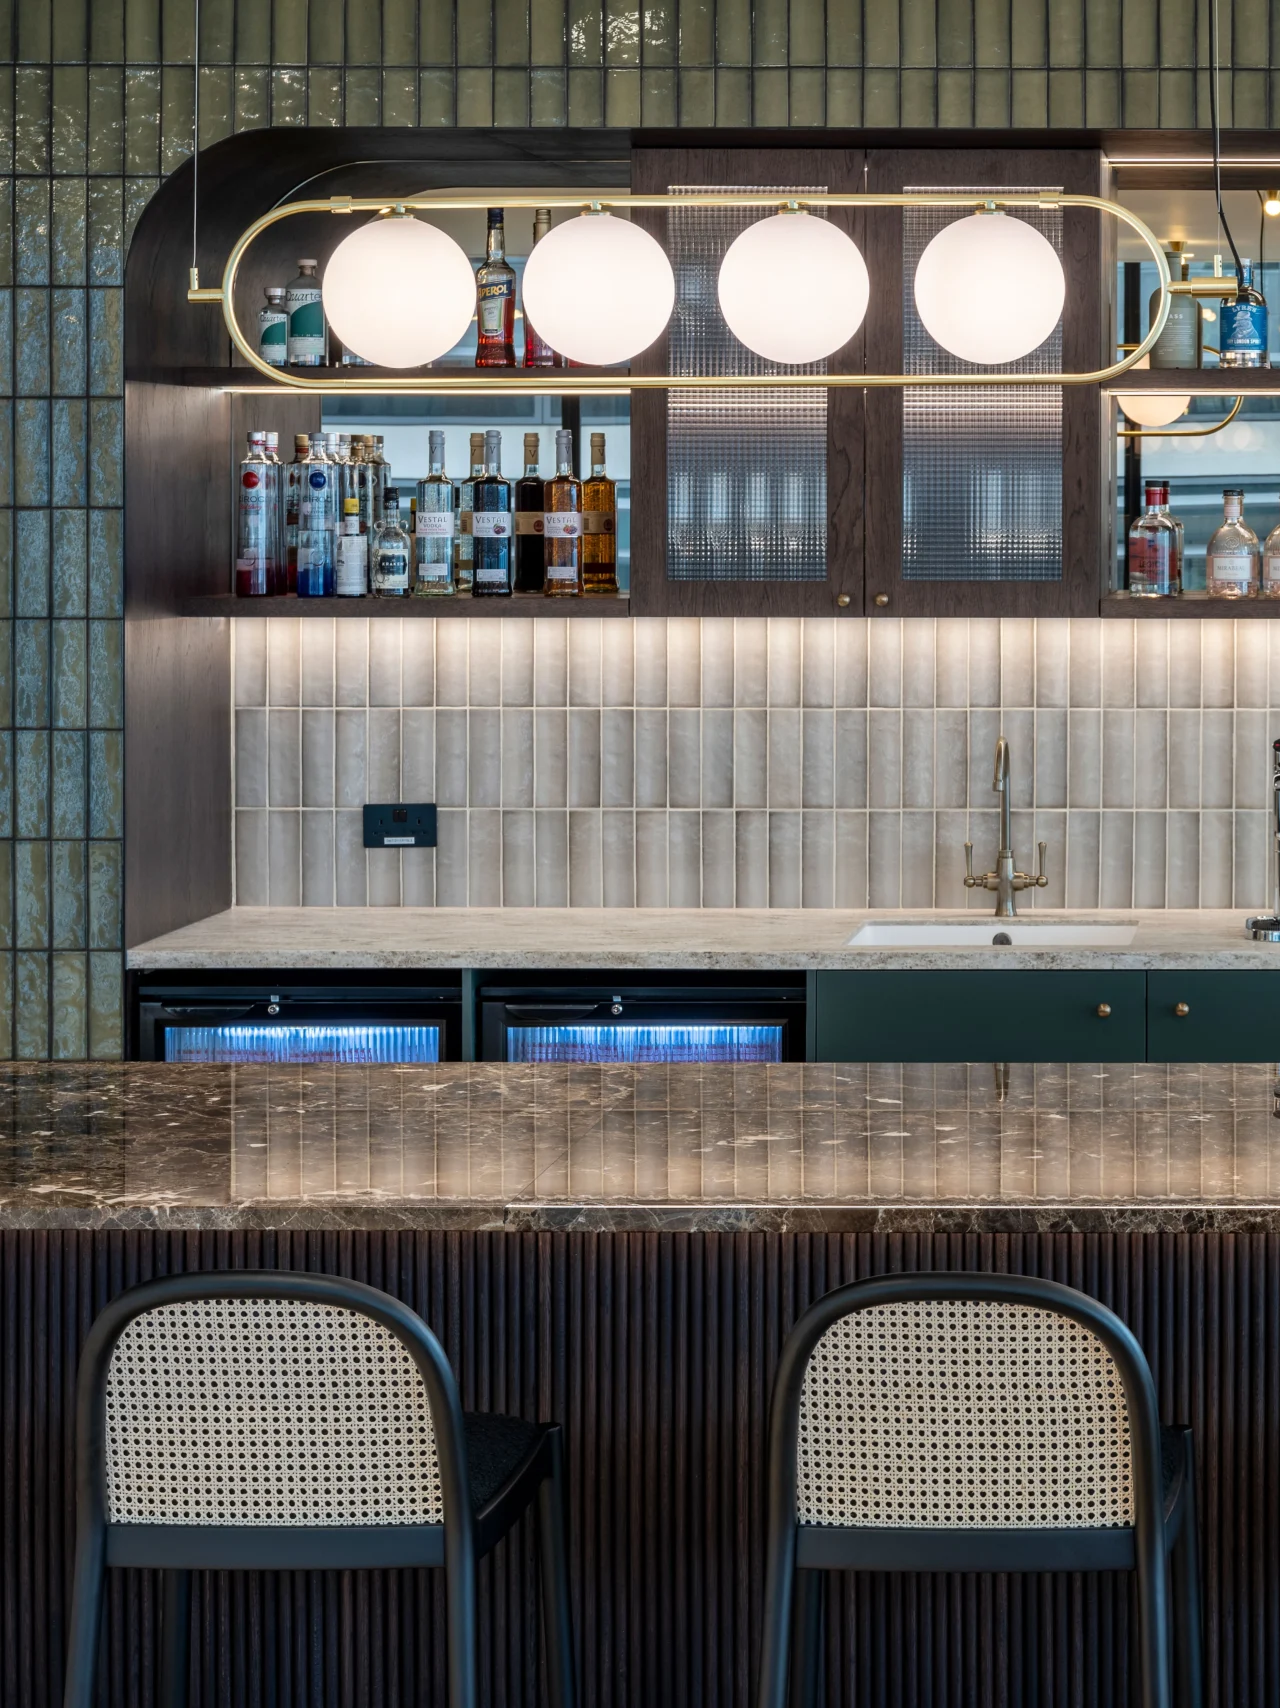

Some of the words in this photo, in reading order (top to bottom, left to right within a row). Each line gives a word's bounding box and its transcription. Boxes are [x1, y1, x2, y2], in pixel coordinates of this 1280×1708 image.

[478, 284, 509, 298] APEROL
[286, 291, 321, 302] Quarte
[1232, 304, 1258, 313] LYRE'S
[260, 314, 287, 323] Quarter
[430, 446, 437, 454] V
[489, 446, 496, 454] V
[529, 450, 536, 458] V
[565, 446, 571, 455] V
[598, 448, 605, 457] V
[417, 514, 448, 523] VESTAL
[475, 515, 506, 524] VESTAL
[546, 515, 577, 524] VESTAL
